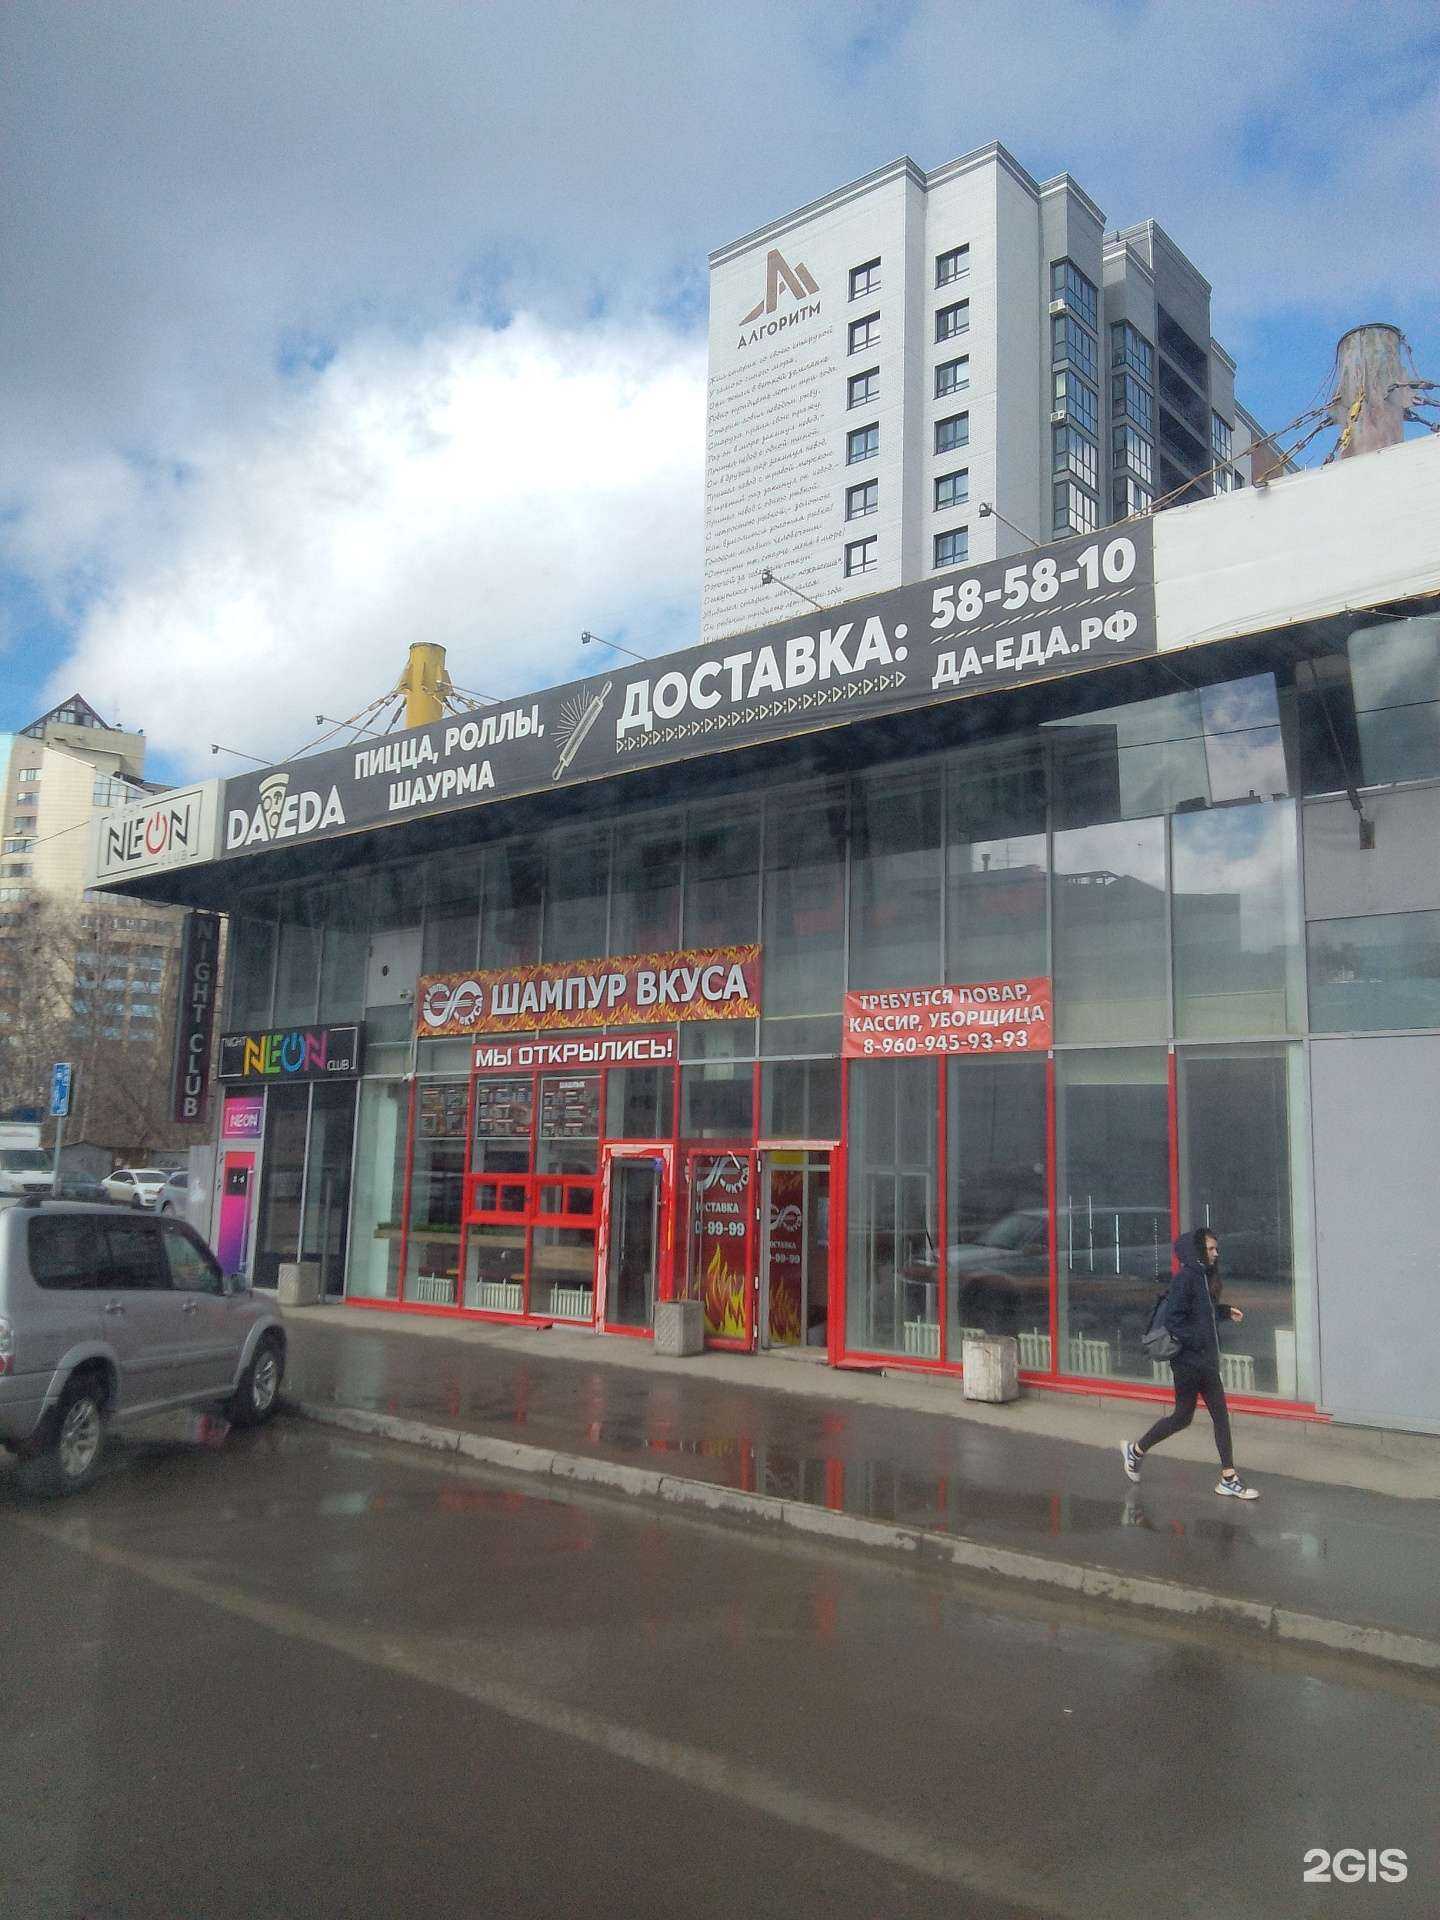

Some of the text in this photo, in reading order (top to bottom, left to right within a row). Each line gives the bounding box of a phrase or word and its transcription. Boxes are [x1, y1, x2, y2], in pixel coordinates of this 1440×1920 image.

[738, 301, 821, 349] АЛГОРИТМ
[929, 537, 1137, 630] 58-58-10
[931, 609, 1138, 689] ДА-ЕДА.РФ
[616, 615, 908, 738] ДОСТАВКА:
[354, 704, 544, 780] ПИЦЦА, РОЛЛЫ,
[388, 760, 495, 811] ШАУРМА
[107, 804, 190, 866] NEON
[491, 974, 627, 1016] ШАМПУР
[636, 964, 748, 1006] ВКУСА
[860, 984, 1031, 1010] ТРЕБУЕТСЯ ПОВАР,
[849, 1005, 1045, 1033] КАССИР, УБОРЩИЦА
[863, 1030, 1029, 1055] 8-960-945-93-93
[184, 1033, 204, 1116] CLUB
[243, 1031, 329, 1078] NEON
[327, 1058, 350, 1072] CLUB
[475, 1038, 673, 1067] МЫ ОТКРЫЛИСЬ!
[229, 1113, 259, 1128] NEON
